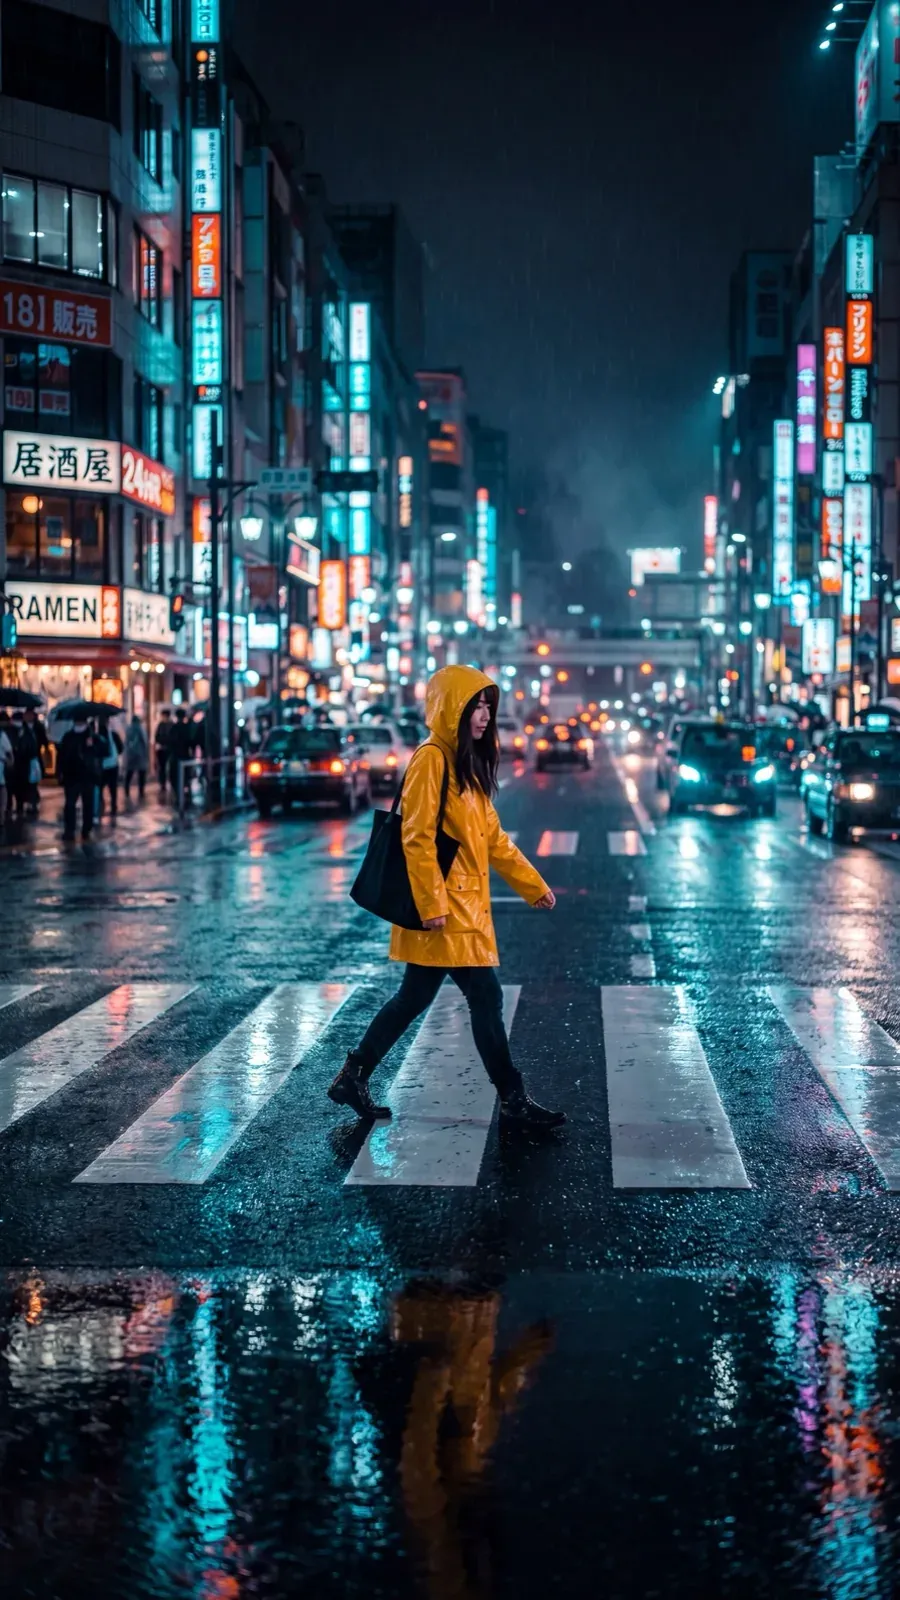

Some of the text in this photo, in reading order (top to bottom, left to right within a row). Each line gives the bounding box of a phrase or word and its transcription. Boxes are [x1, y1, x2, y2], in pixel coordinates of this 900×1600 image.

[53, 299, 97, 339] 販売
[12, 442, 113, 483] 居酒屋
[9, 595, 97, 622] RAMEN
